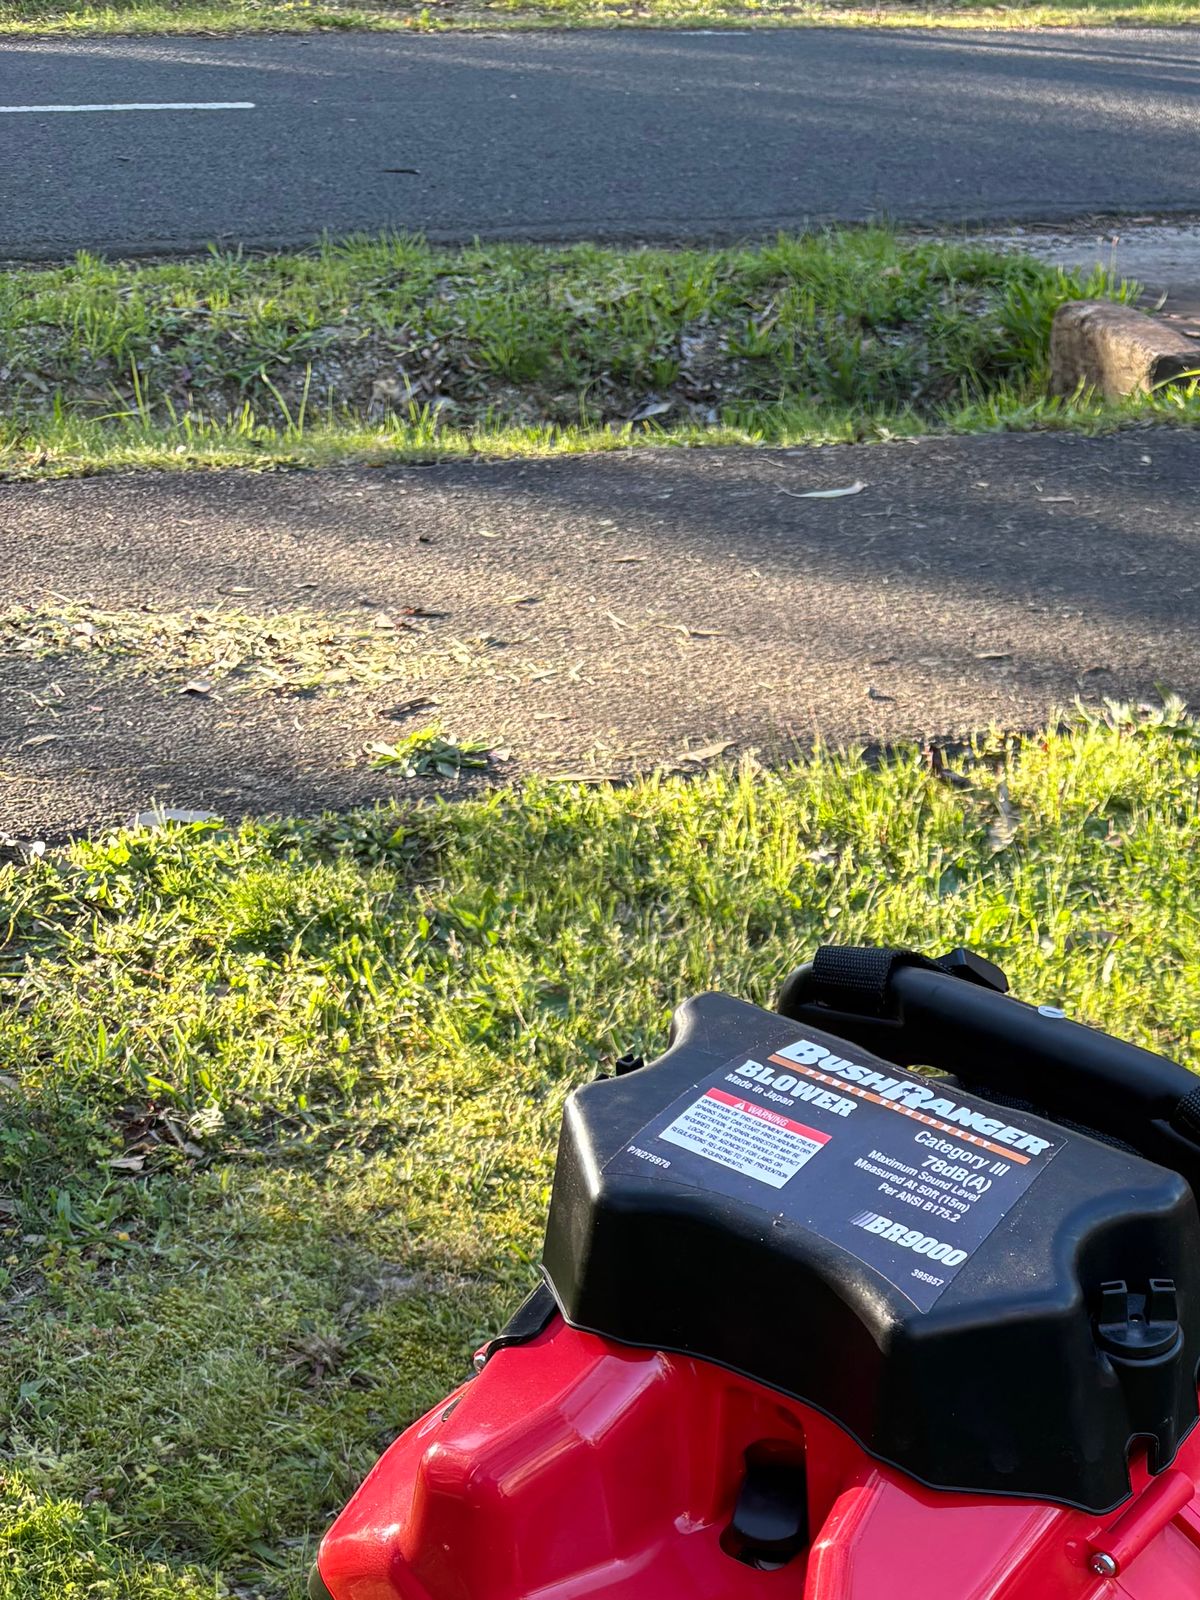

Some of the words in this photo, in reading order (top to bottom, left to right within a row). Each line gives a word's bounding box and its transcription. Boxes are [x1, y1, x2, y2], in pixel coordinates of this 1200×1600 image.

[725, 1073, 753, 1090] Made
[753, 1083, 764, 1095] in
[764, 1087, 794, 1107] Japan
[734, 1060, 858, 1118] BLOWER
[747, 1106, 789, 1126] WARNING
[914, 1130, 990, 1169] Category
[988, 1161, 1010, 1176] III
[921, 1154, 992, 1194] 78dB(A)
[854, 1157, 906, 1184] Measured
[903, 1177, 917, 1190] At
[916, 1184, 940, 1199] 50ft
[938, 1194, 970, 1213] (15m)
[868, 1149, 918, 1176] Maximum
[918, 1171, 952, 1191] Sound
[951, 1185, 981, 1202] Level
[878, 1182, 898, 1196] Per
[896, 1190, 922, 1207] ANSI
[922, 1202, 961, 1223] B175.2
[863, 1215, 968, 1267] BR9000
[911, 1269, 944, 1287] 395857
